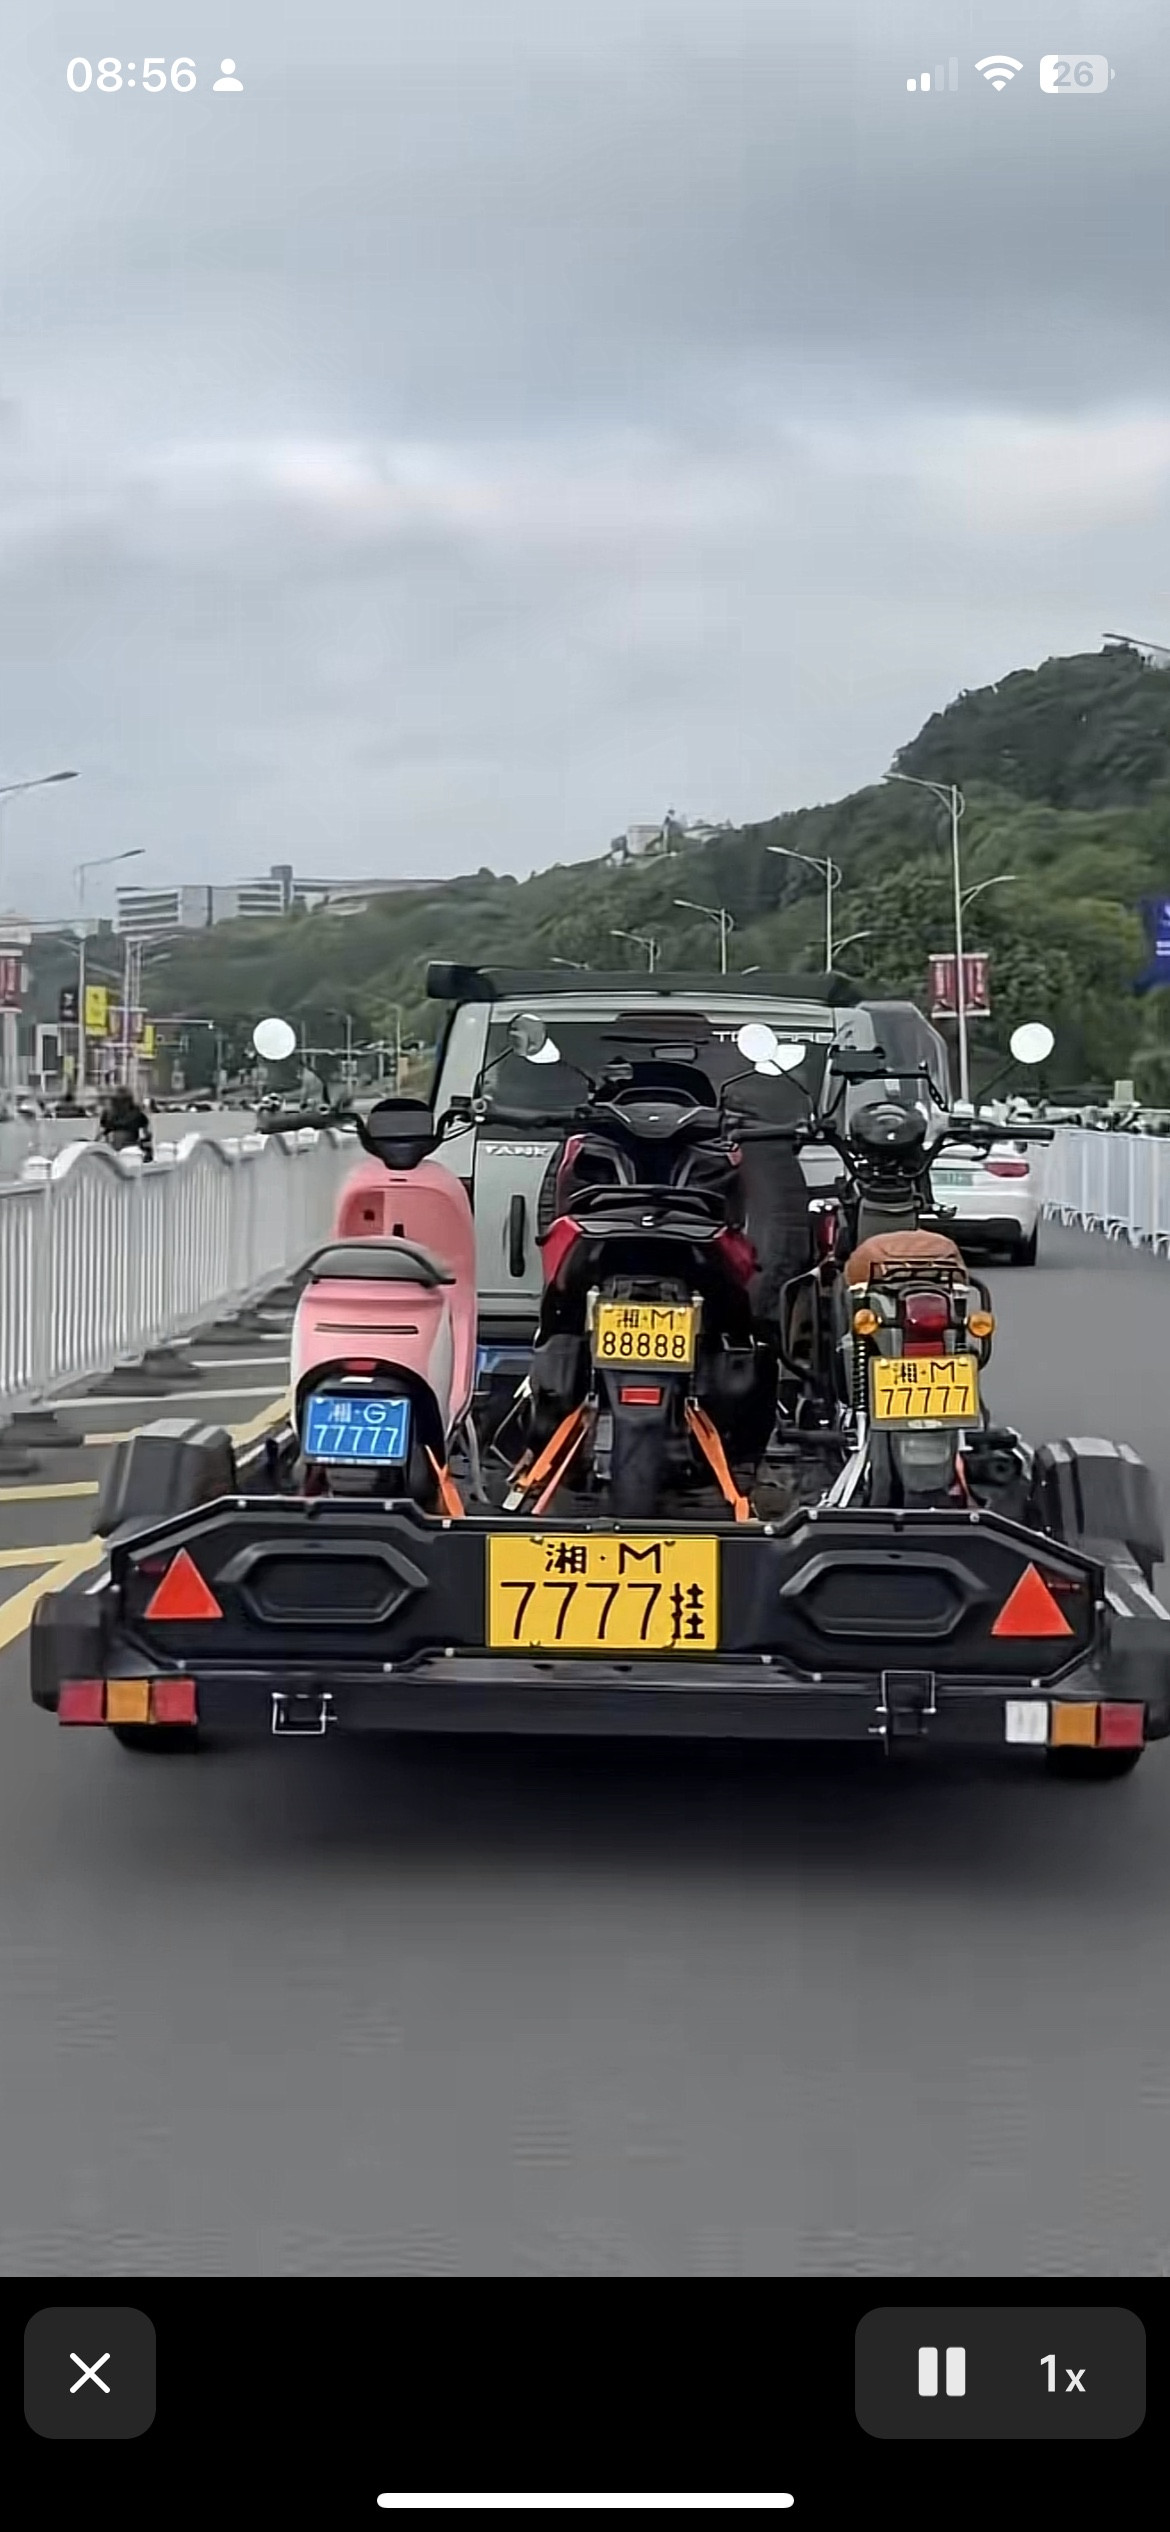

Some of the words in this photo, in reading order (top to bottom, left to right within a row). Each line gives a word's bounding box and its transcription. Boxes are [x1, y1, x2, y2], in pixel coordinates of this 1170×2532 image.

[485, 1145, 550, 1156] TANK
[602, 1331, 686, 1358] 88888
[880, 1386, 969, 1415] 77777
[313, 1424, 399, 1454] 77777
